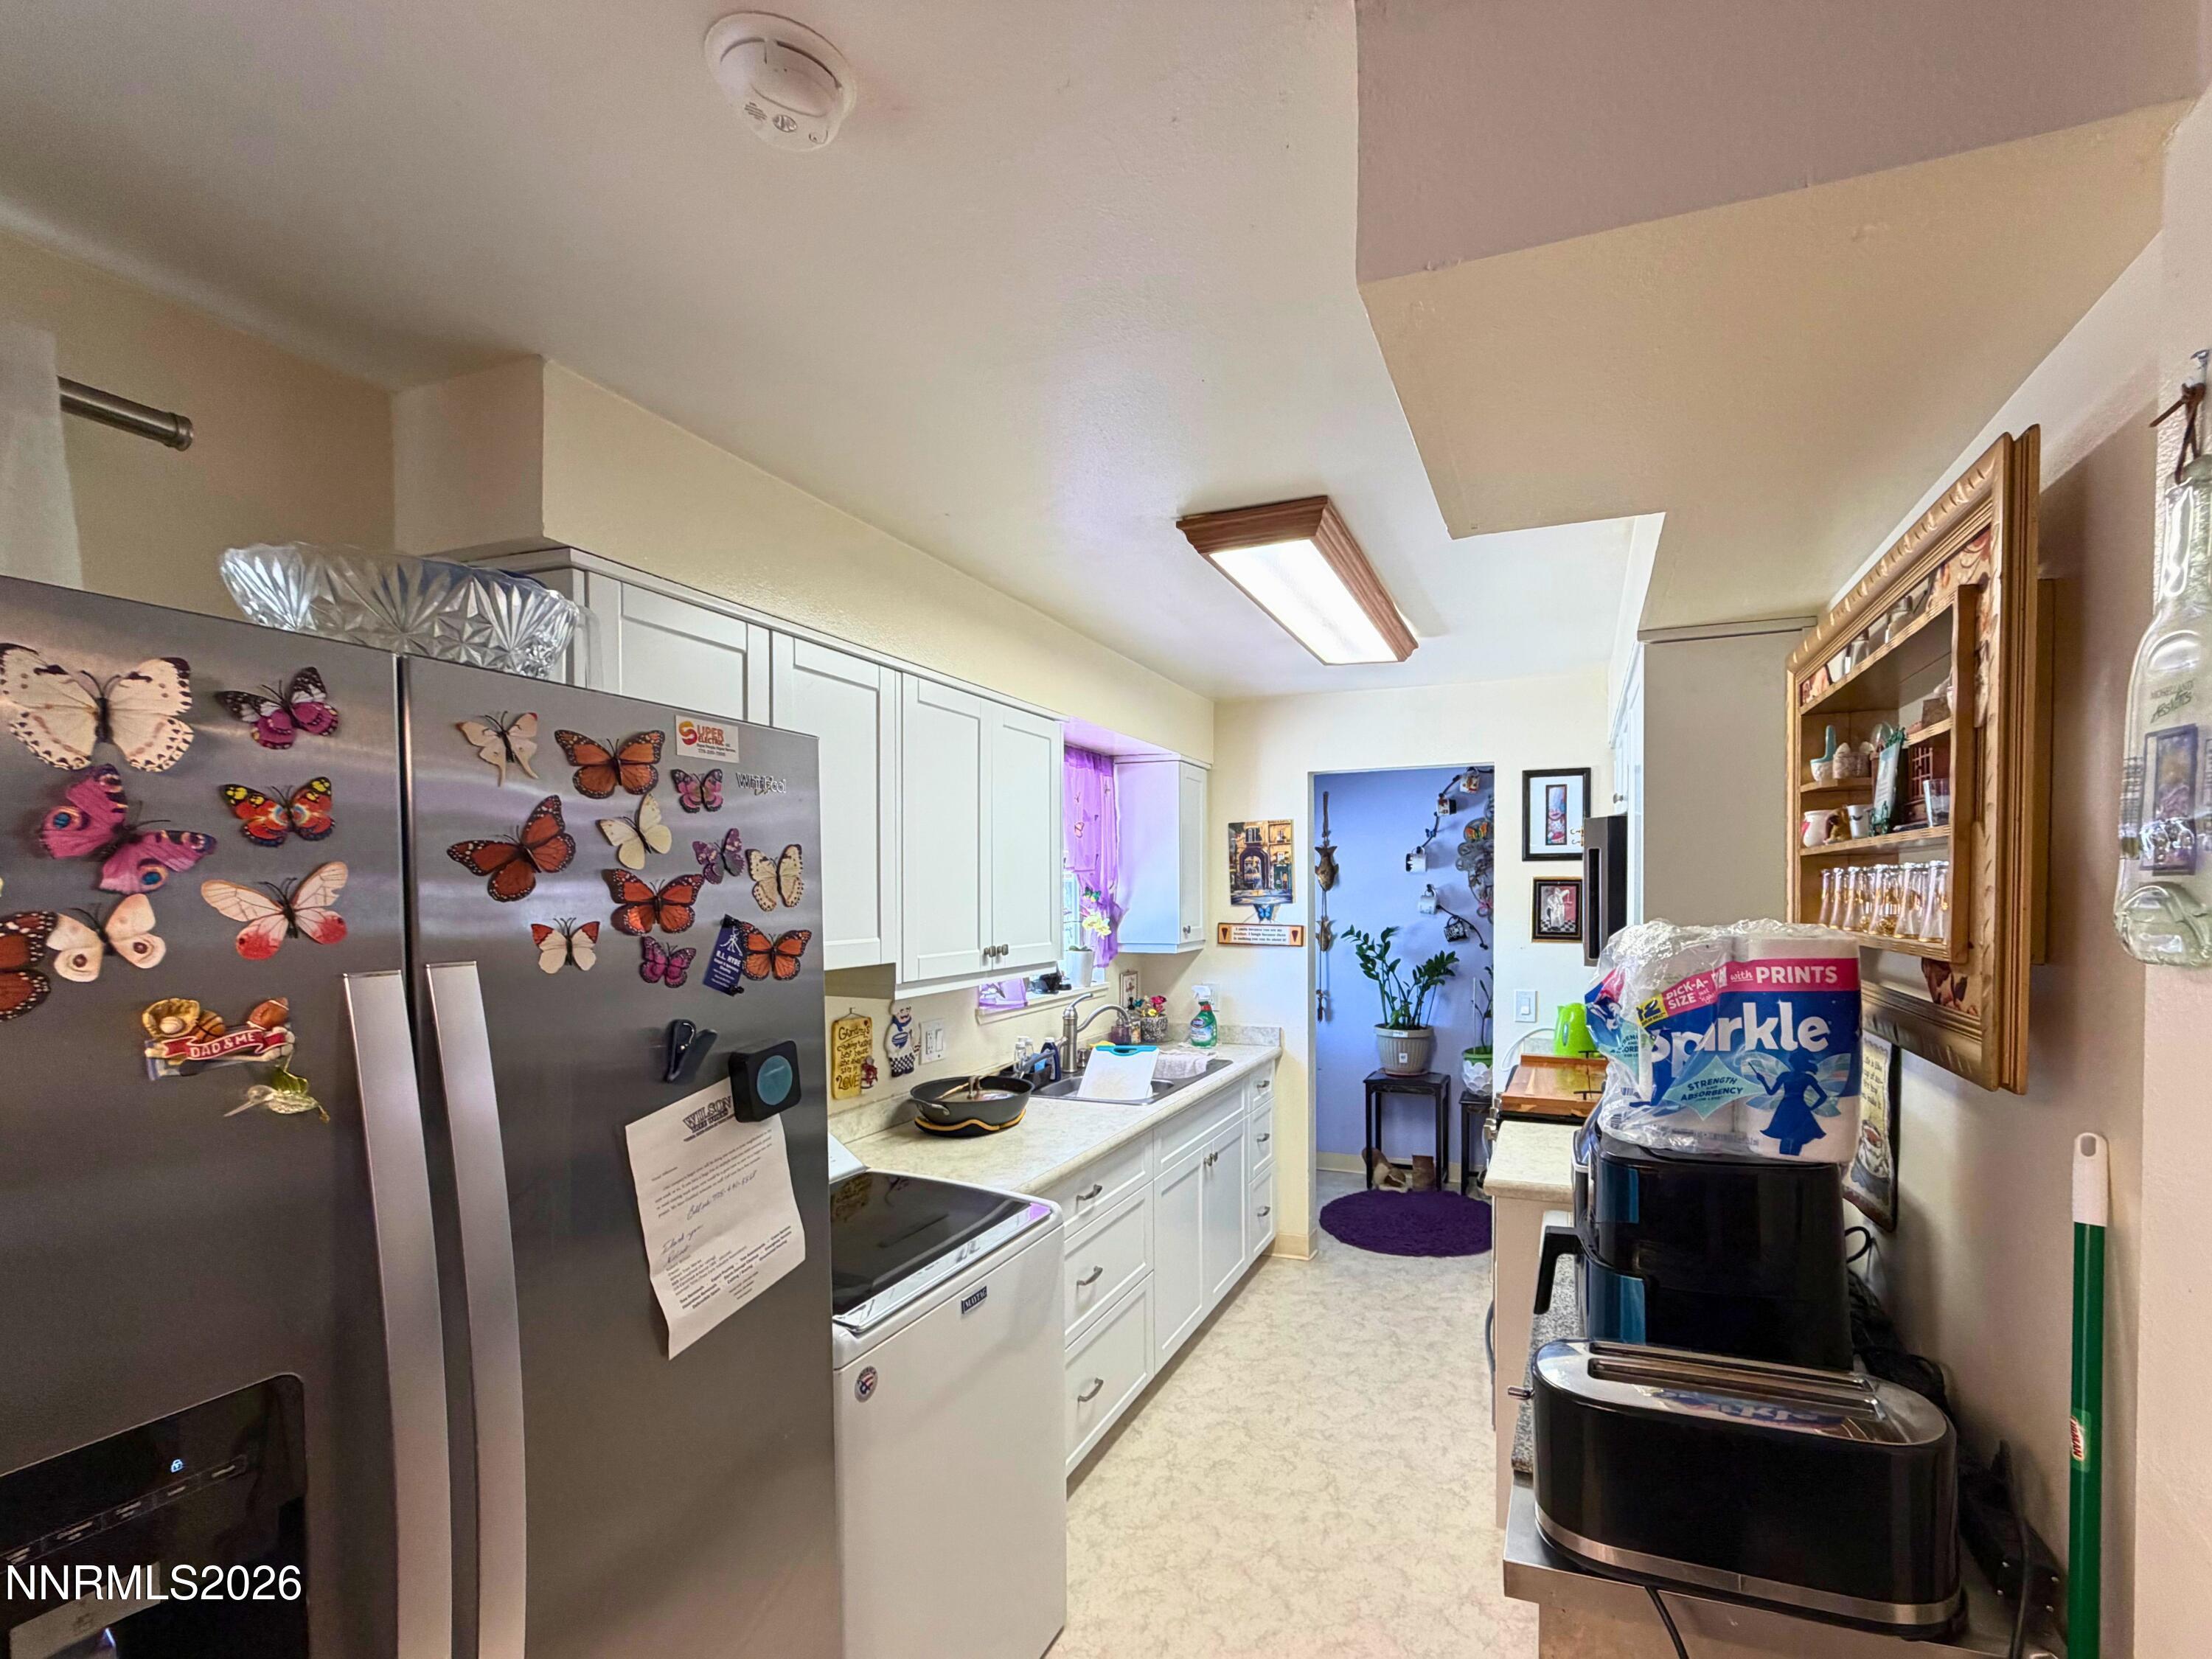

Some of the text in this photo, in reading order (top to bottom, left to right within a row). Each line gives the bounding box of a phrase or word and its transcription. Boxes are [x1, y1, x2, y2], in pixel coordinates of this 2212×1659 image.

[735, 772, 787, 794] Whirlpool
[1730, 970, 1753, 982] with
[1756, 966, 1837, 984] PRINTS
[1636, 999, 1661, 1022] 12
[1668, 993, 1697, 1009] SIZE
[189, 1032, 256, 1058] DAD & ME
[1681, 1087, 1743, 1102] ABSORBENCY
[1688, 1077, 1738, 1091] STRENGTH
[683, 1096, 732, 1130] WILSON
[965, 1287, 987, 1309] MAYTAG
